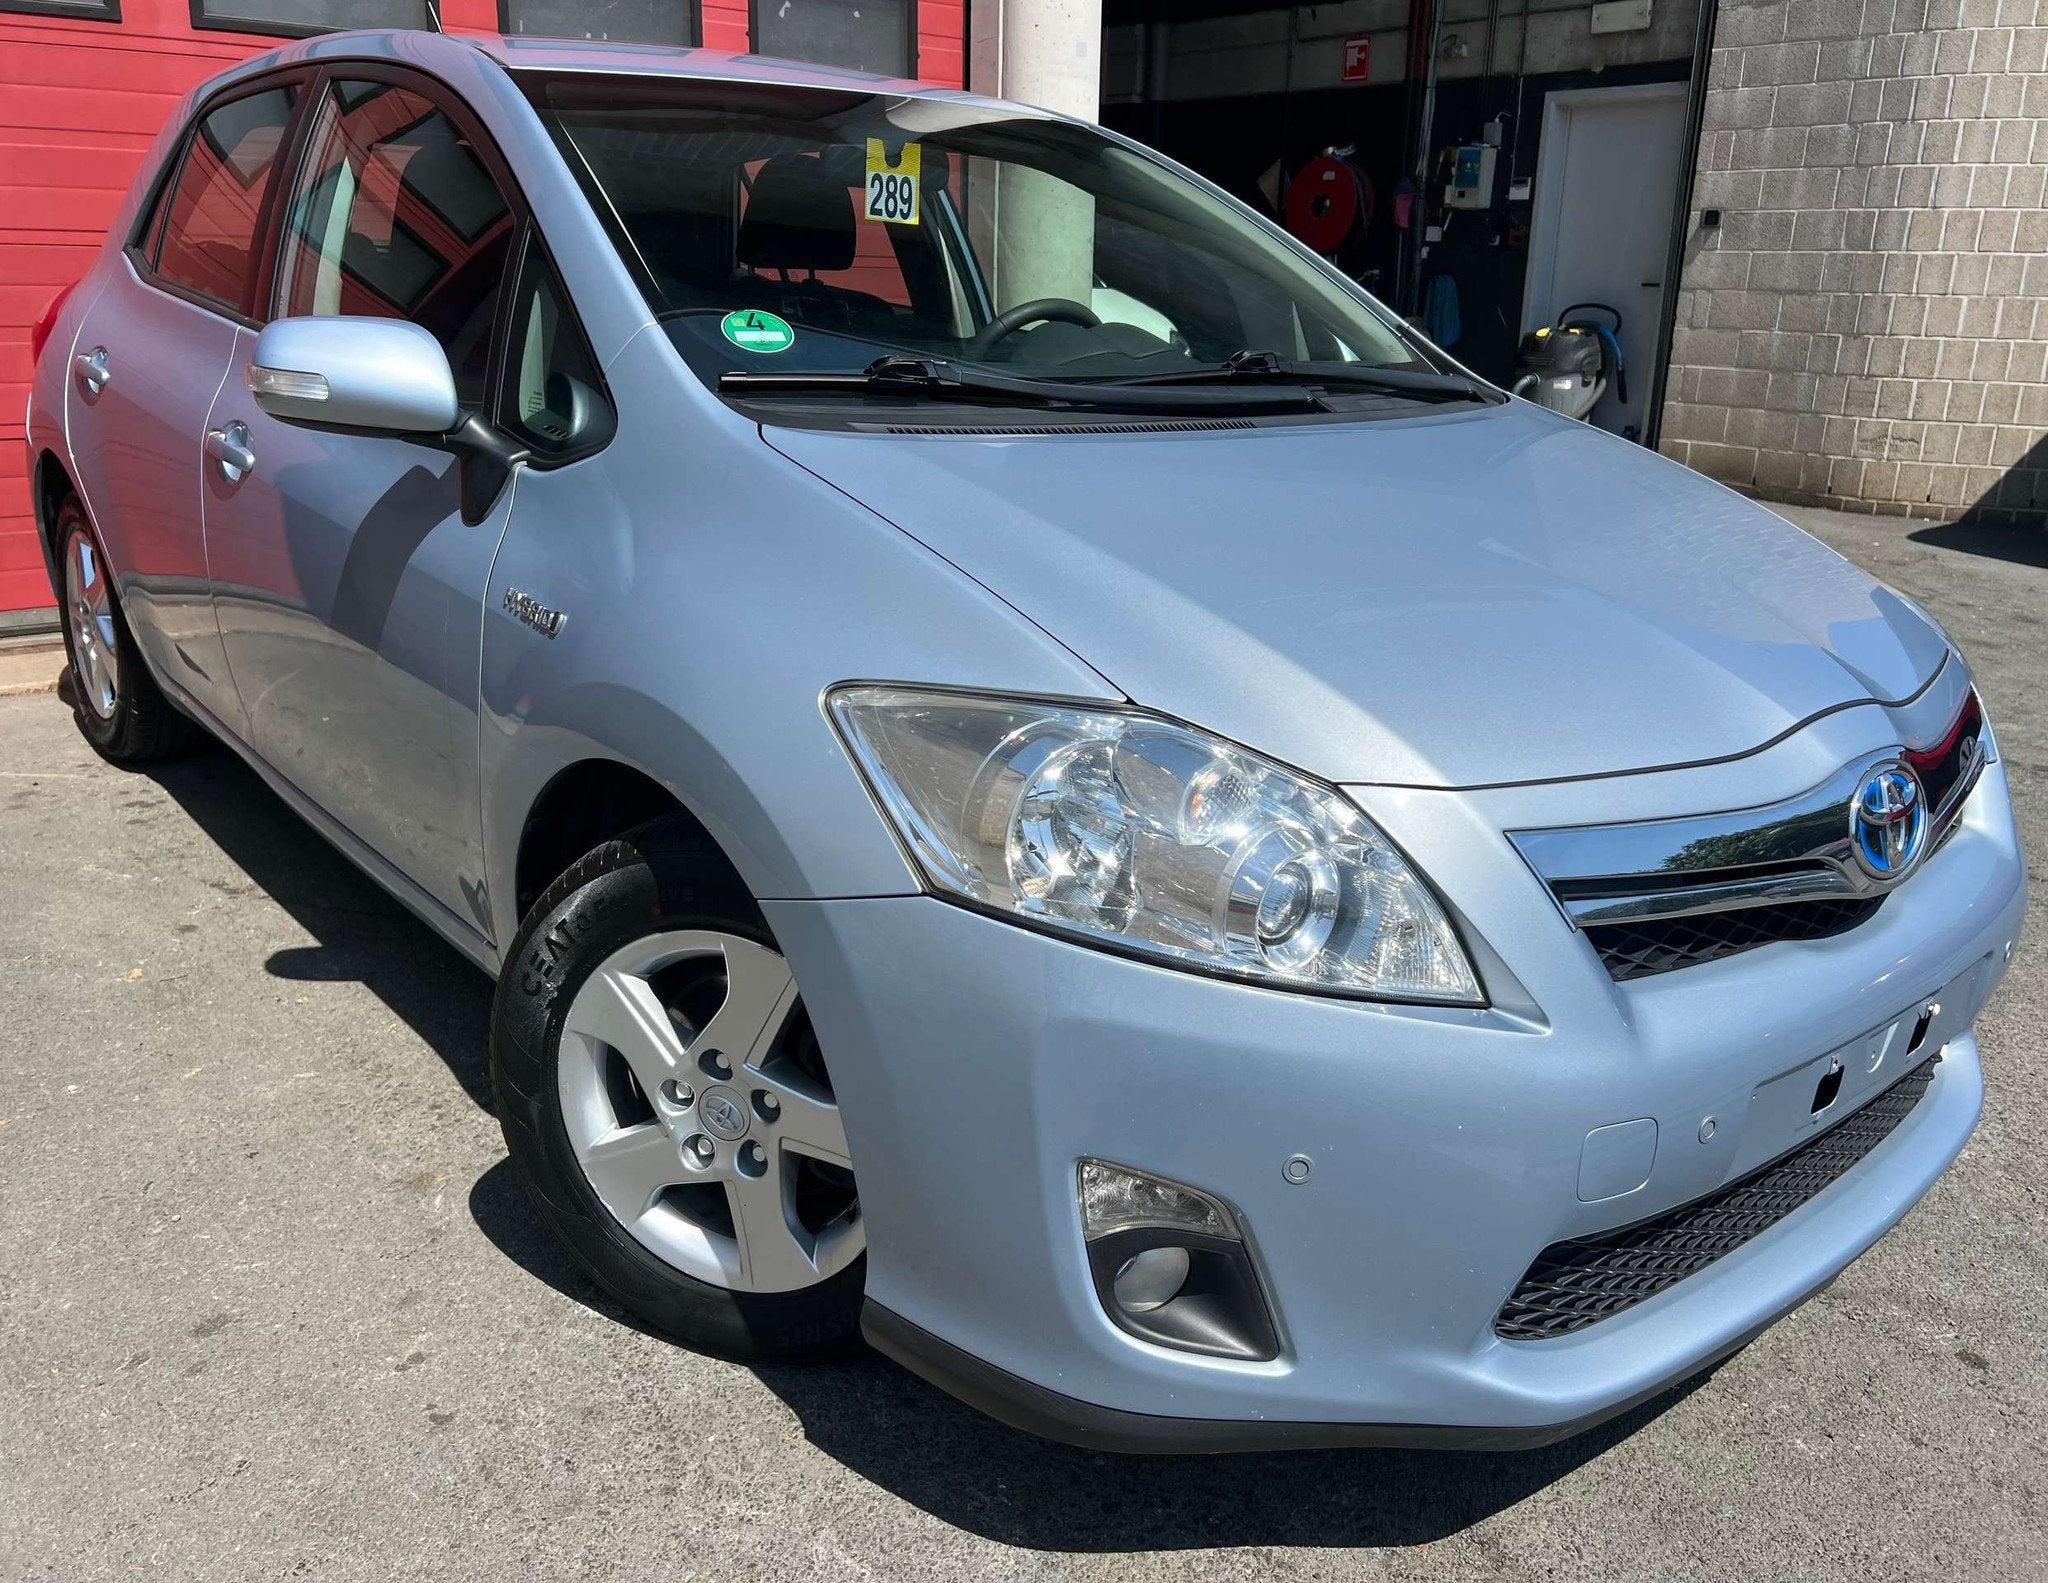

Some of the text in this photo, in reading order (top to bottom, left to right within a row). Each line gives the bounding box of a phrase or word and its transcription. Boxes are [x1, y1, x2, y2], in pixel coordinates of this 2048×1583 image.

[869, 172, 913, 220] 289
[746, 312, 766, 331] 4
[503, 586, 568, 637] HYBRID
[520, 917, 577, 997] CEAT
